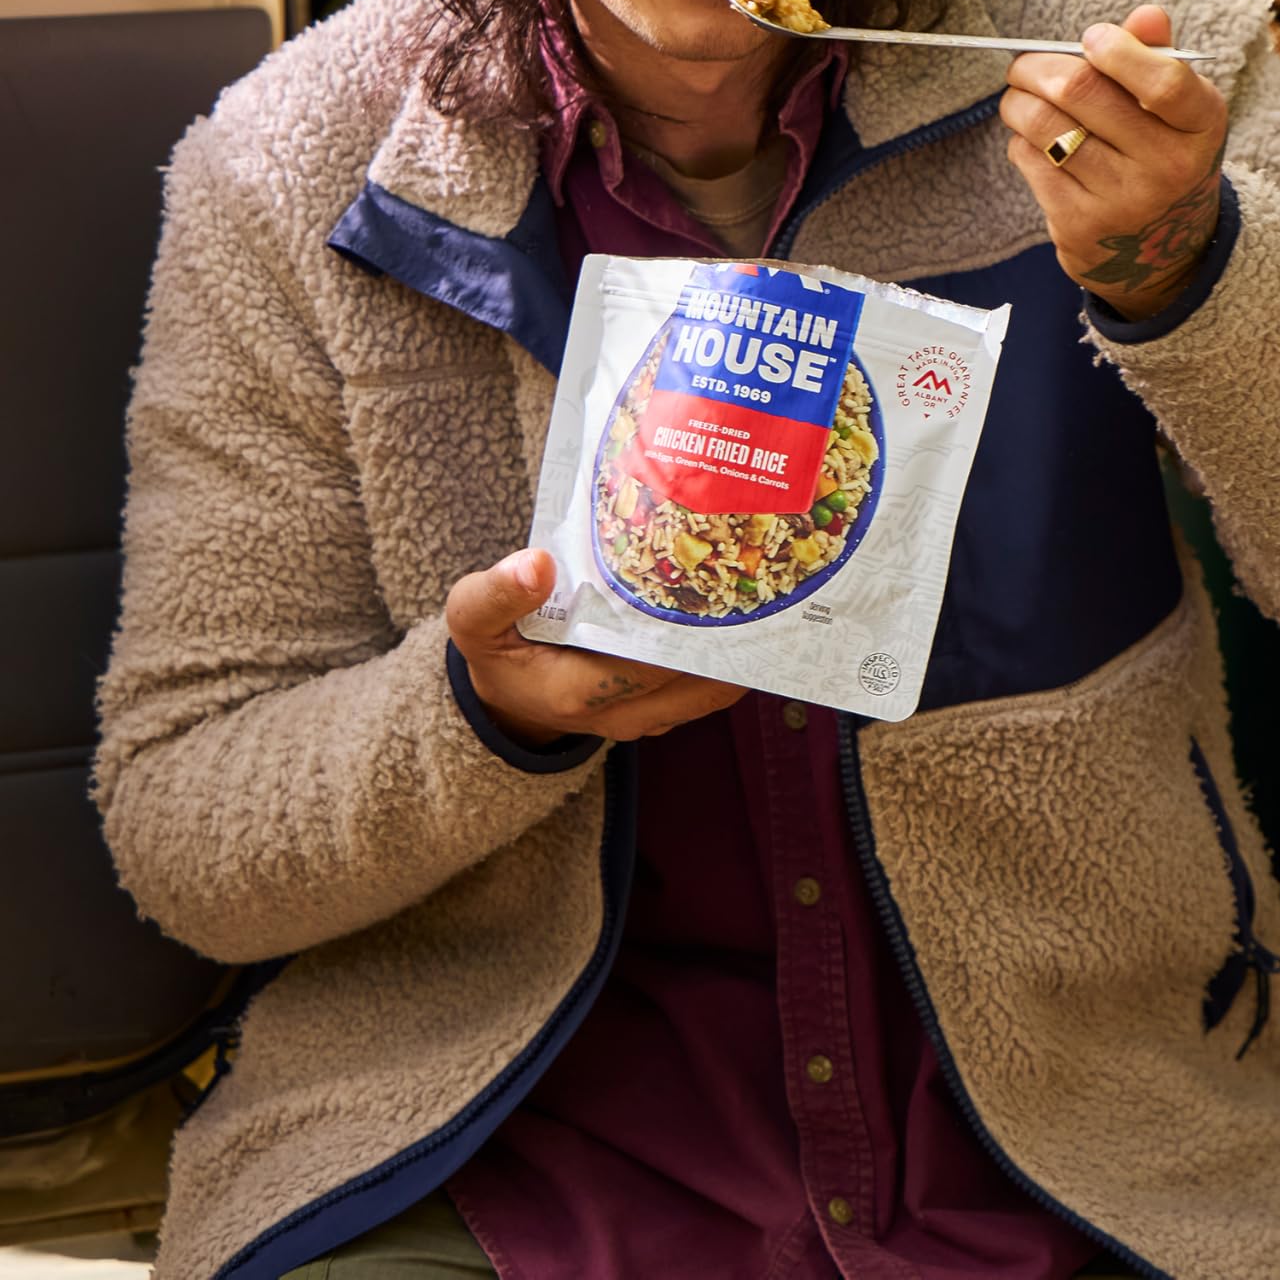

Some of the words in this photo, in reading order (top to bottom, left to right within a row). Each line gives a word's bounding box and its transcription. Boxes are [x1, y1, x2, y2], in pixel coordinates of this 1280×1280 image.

[685, 288, 838, 349] MOUNTAIN
[915, 357, 938, 372] MADE
[691, 374, 730, 395] ESTD.
[733, 383, 772, 404] 1969
[896, 365, 911, 406] GREAT
[907, 345, 945, 363] TASTE
[946, 351, 971, 418] GUARANTEE
[914, 391, 949, 404] ALBANY
[923, 400, 936, 408] OR
[687, 418, 751, 440] FREEZE-DRIED
[653, 426, 707, 455] CHICKEN
[705, 436, 750, 466] FRIED
[750, 448, 789, 475] RICE
[675, 456, 698, 469] Green
[698, 461, 719, 474] Peas,
[719, 466, 750, 480] Onions
[750, 473, 757, 482] &
[758, 475, 790, 490] Carrots
